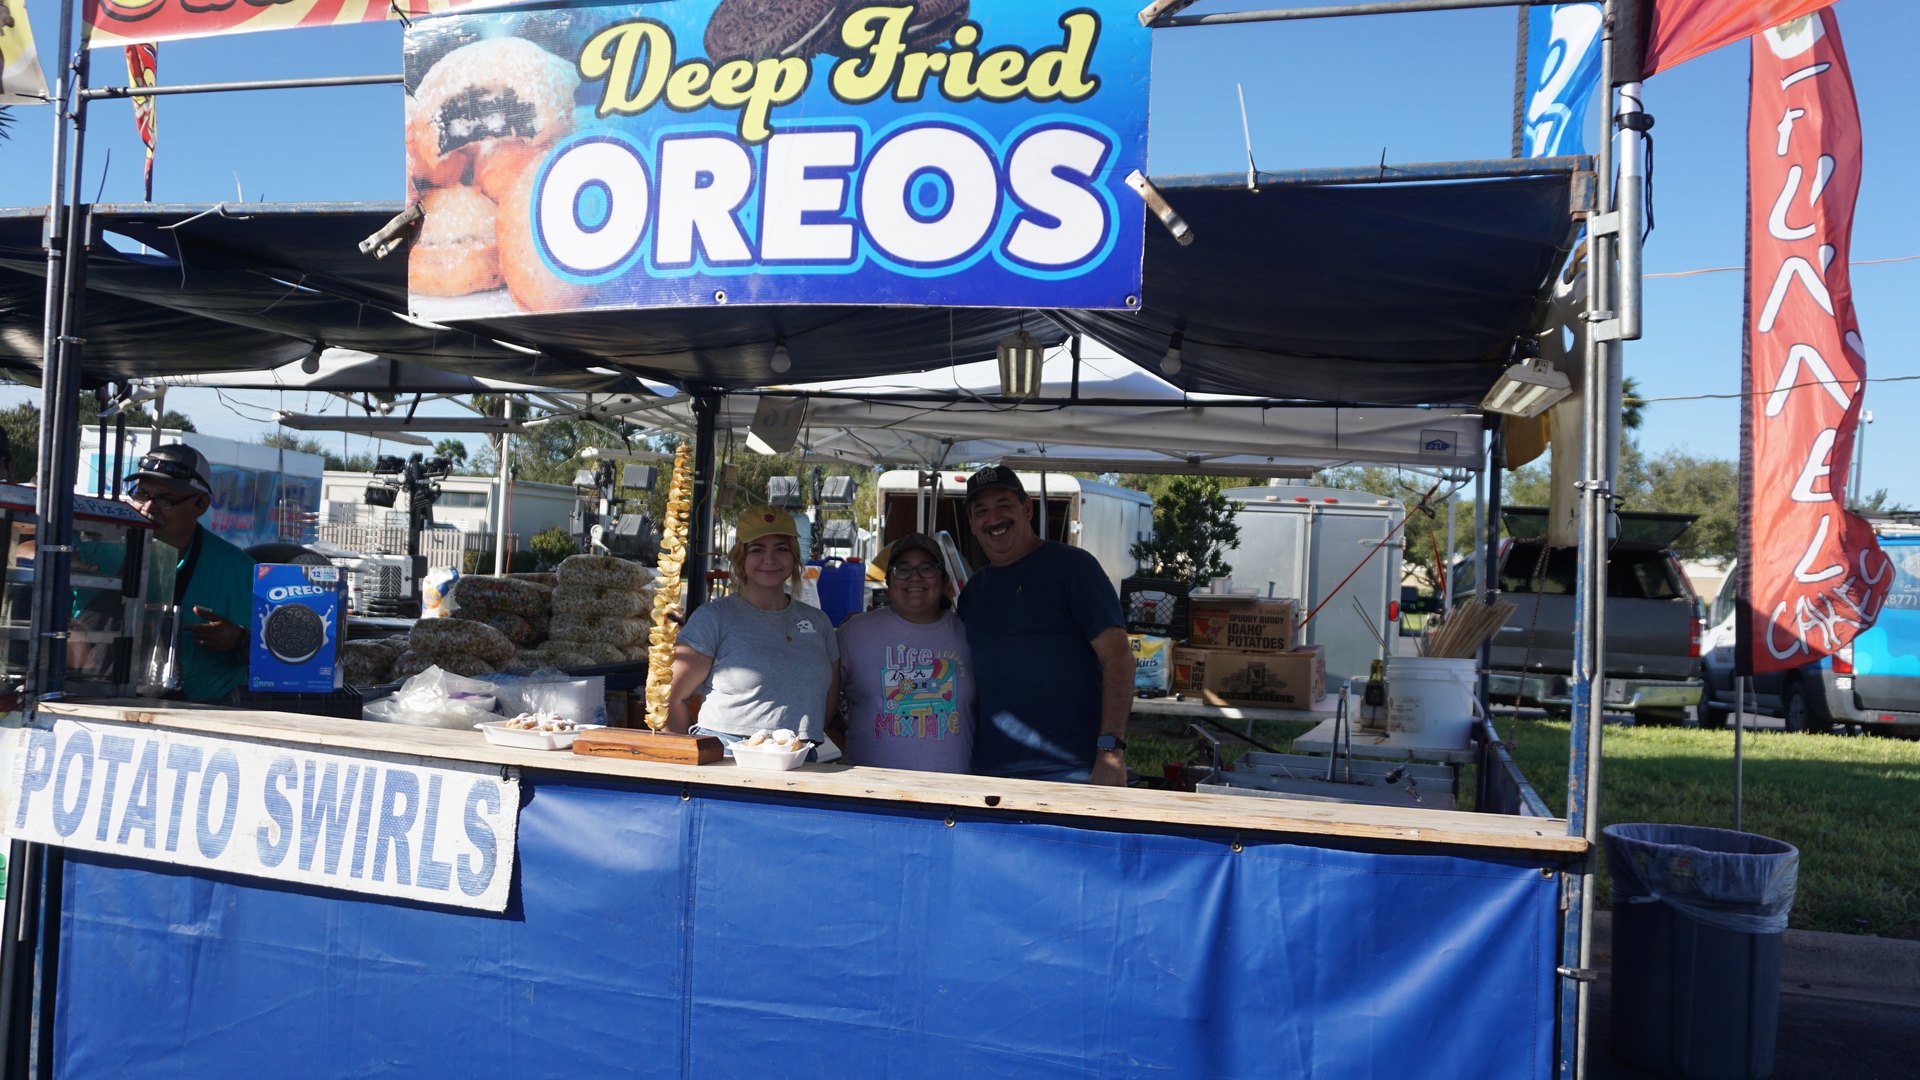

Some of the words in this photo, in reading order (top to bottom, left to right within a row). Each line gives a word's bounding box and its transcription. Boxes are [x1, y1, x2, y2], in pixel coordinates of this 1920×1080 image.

[579, 20, 810, 142] Deep
[837, 8, 1098, 102] Fried
[540, 127, 1109, 270] OREOS
[312, 570, 321, 578] 12
[268, 585, 323, 602] OREO
[1229, 614, 1258, 623] SPUDDY
[1260, 615, 1284, 625] BUDDY
[1227, 635, 1285, 650] POTATOES
[885, 645, 933, 673] Life
[1136, 657, 1159, 668] kins
[891, 669, 905, 682] is
[15, 727, 241, 860] POTATO
[256, 755, 501, 897] SWIRLS
